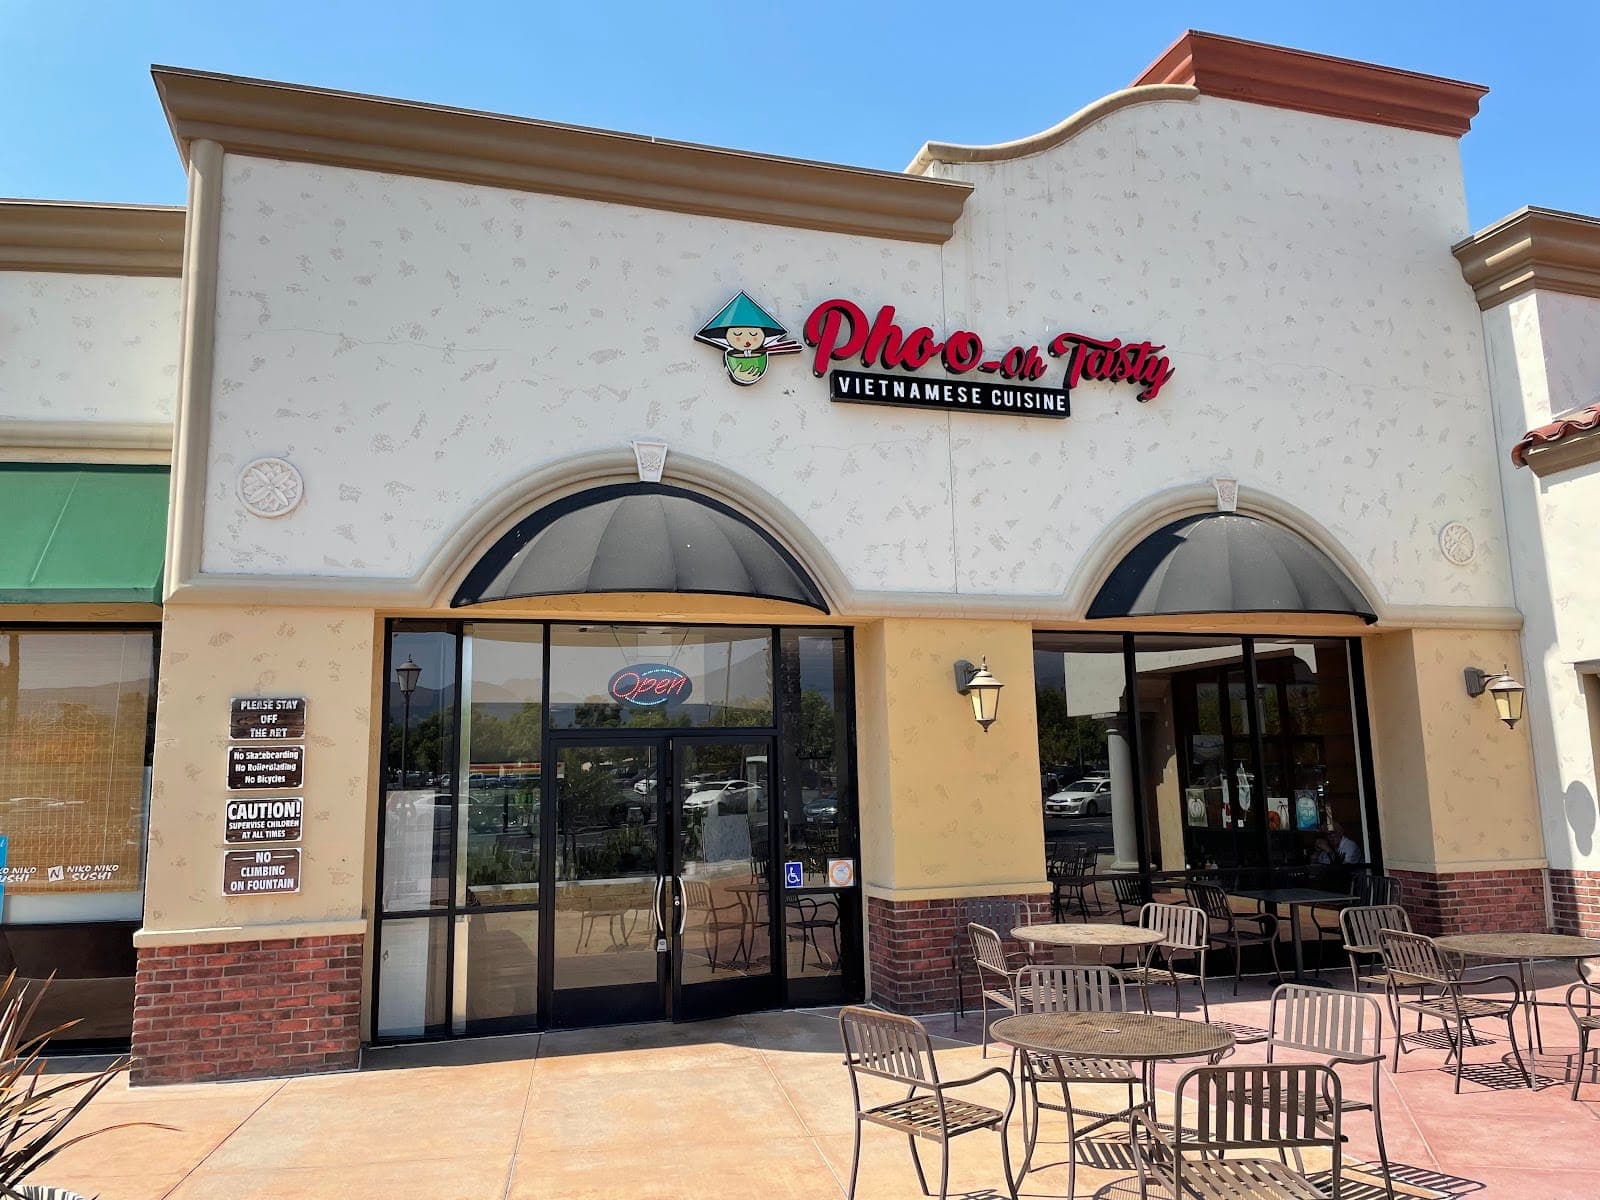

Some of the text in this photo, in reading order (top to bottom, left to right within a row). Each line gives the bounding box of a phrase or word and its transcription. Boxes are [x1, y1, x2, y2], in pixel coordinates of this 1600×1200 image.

[1047, 332, 1176, 403] Tasty
[838, 376, 1066, 411] VIETNAMESE CUISINE
[612, 672, 687, 700] Open
[240, 700, 298, 710] PLEASE STAY
[260, 714, 278, 724] OFF
[250, 727, 288, 738] THE ART
[233, 750, 299, 760] No Skateboarding
[235, 763, 246, 772] No
[244, 774, 286, 784] No Bicycles
[227, 801, 301, 820] CAUTION!
[228, 819, 300, 830] SUPERVISE CHILDREN
[241, 829, 286, 840] AT ALL TIMES
[255, 851, 272, 863] NO
[12, 866, 37, 874] NIKO
[66, 864, 120, 873] NIKO NIKO
[240, 865, 286, 878] CLIMBING
[71, 871, 112, 882] SUSHI
[230, 878, 295, 892] ON FOUNTAIN
